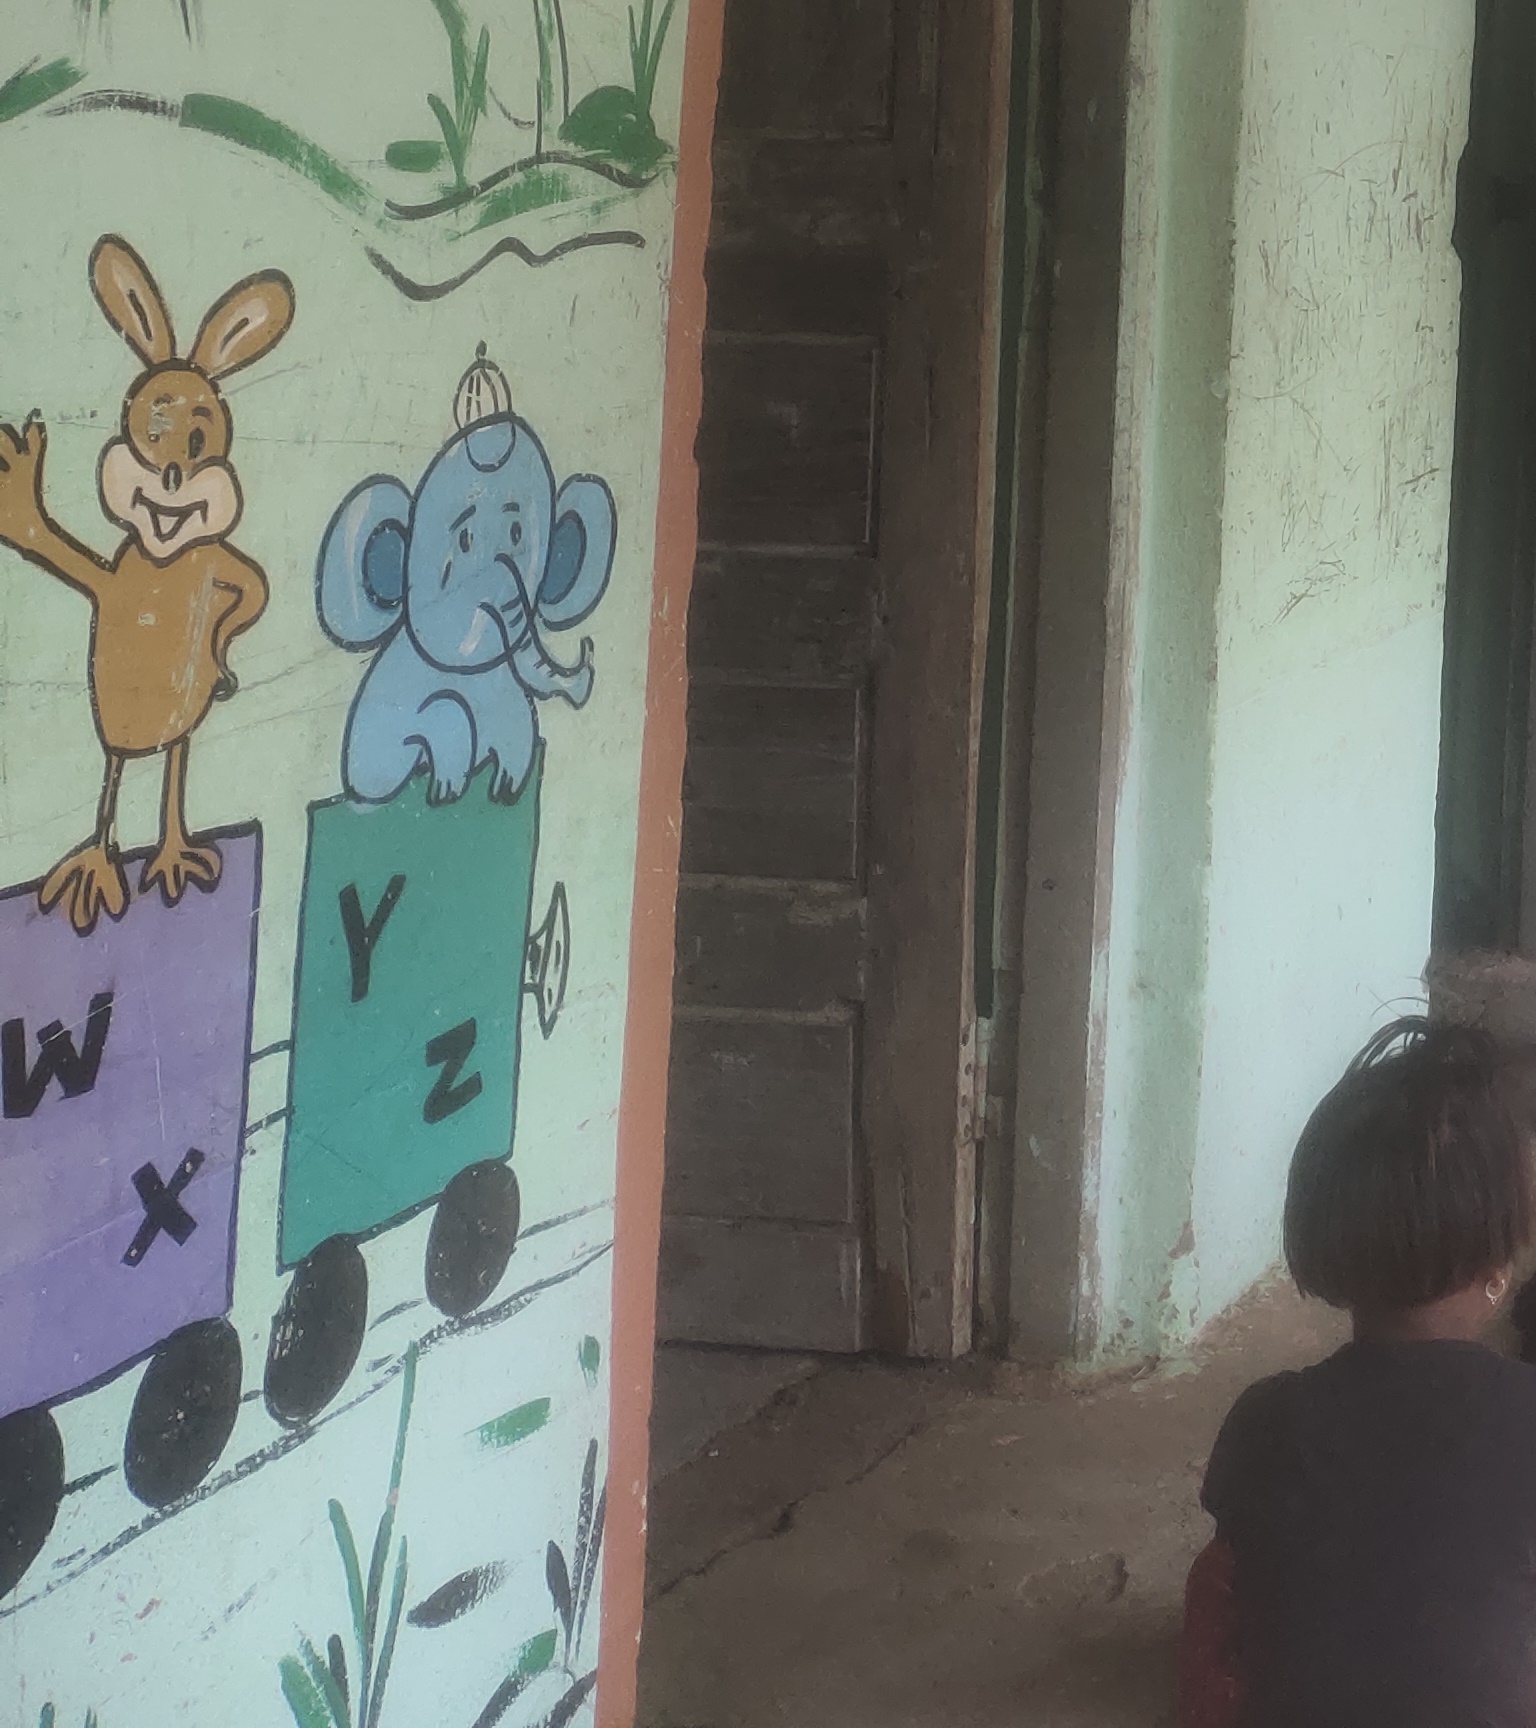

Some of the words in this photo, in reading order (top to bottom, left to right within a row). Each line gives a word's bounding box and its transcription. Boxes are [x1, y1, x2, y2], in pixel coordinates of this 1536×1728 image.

[340, 874, 405, 1003] Y
[0, 991, 114, 1119] W
[423, 1017, 482, 1123] Z
[122, 1147, 205, 1268] X
